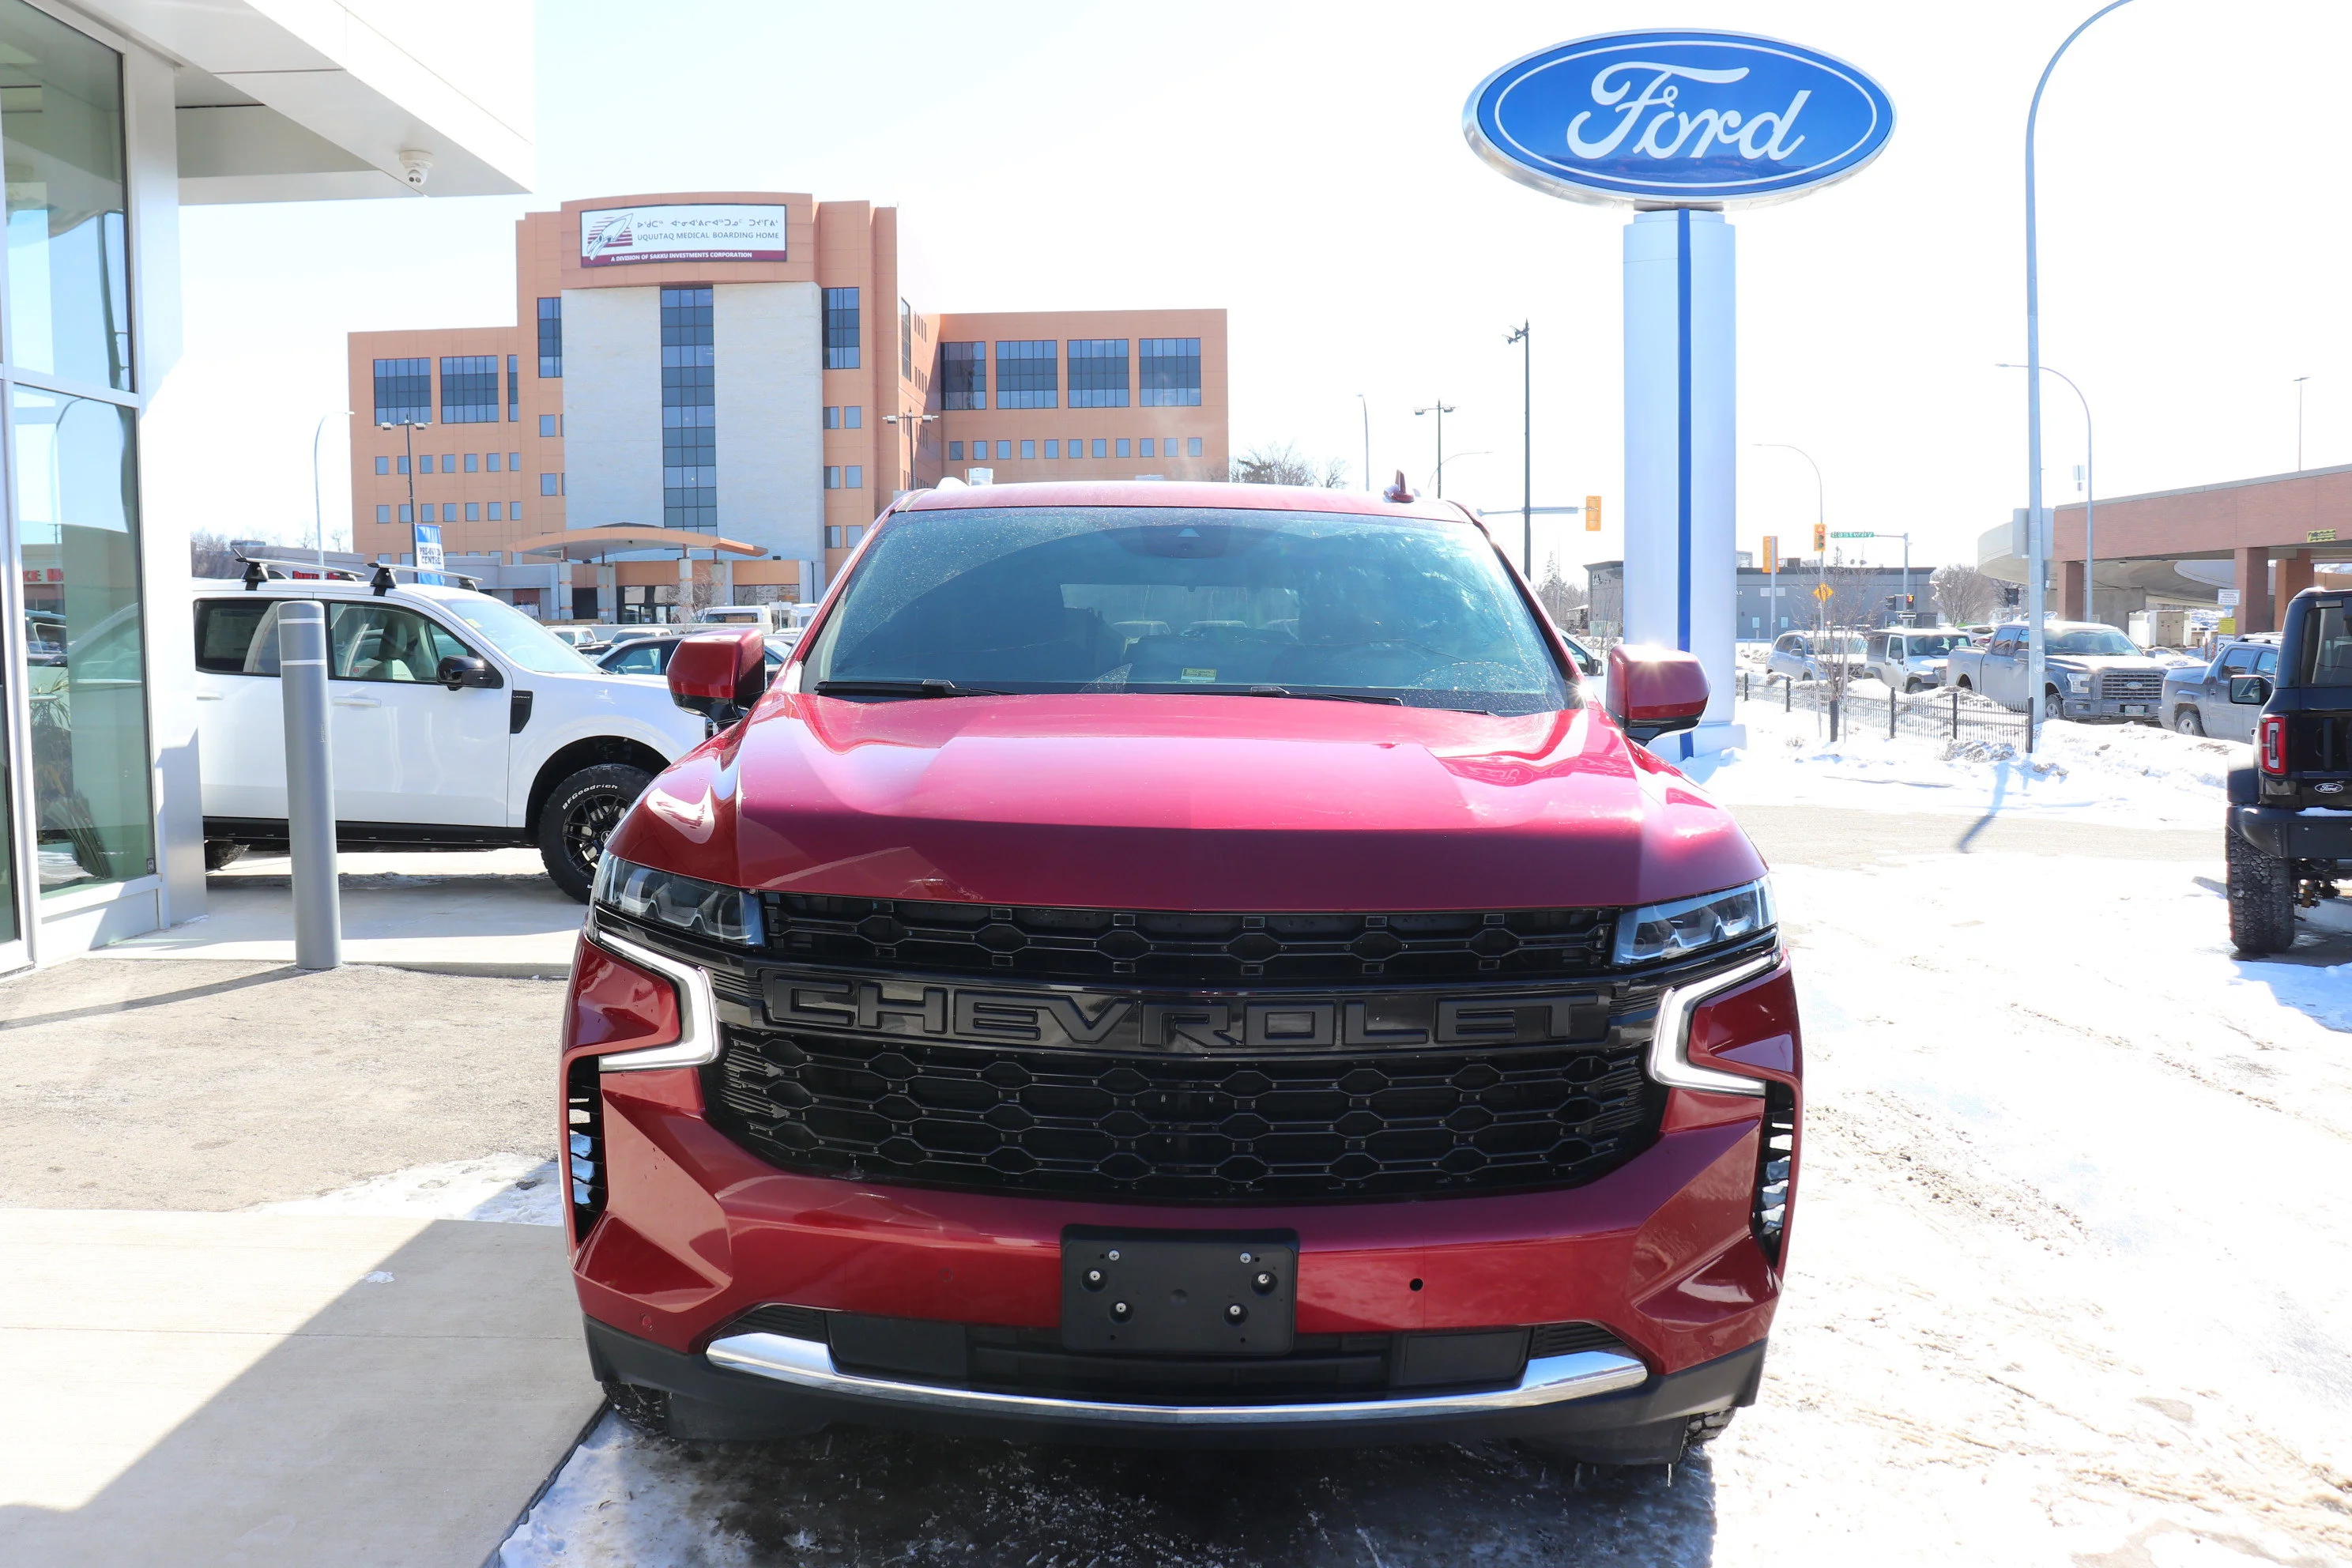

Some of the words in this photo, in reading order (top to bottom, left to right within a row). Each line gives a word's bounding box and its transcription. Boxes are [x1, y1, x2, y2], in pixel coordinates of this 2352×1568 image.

[1566, 61, 1811, 160] Ford
[637, 232, 674, 241] UQUUTAQ
[562, 783, 619, 810] BFGoodrich
[772, 974, 1599, 1047] CHEVROLET
